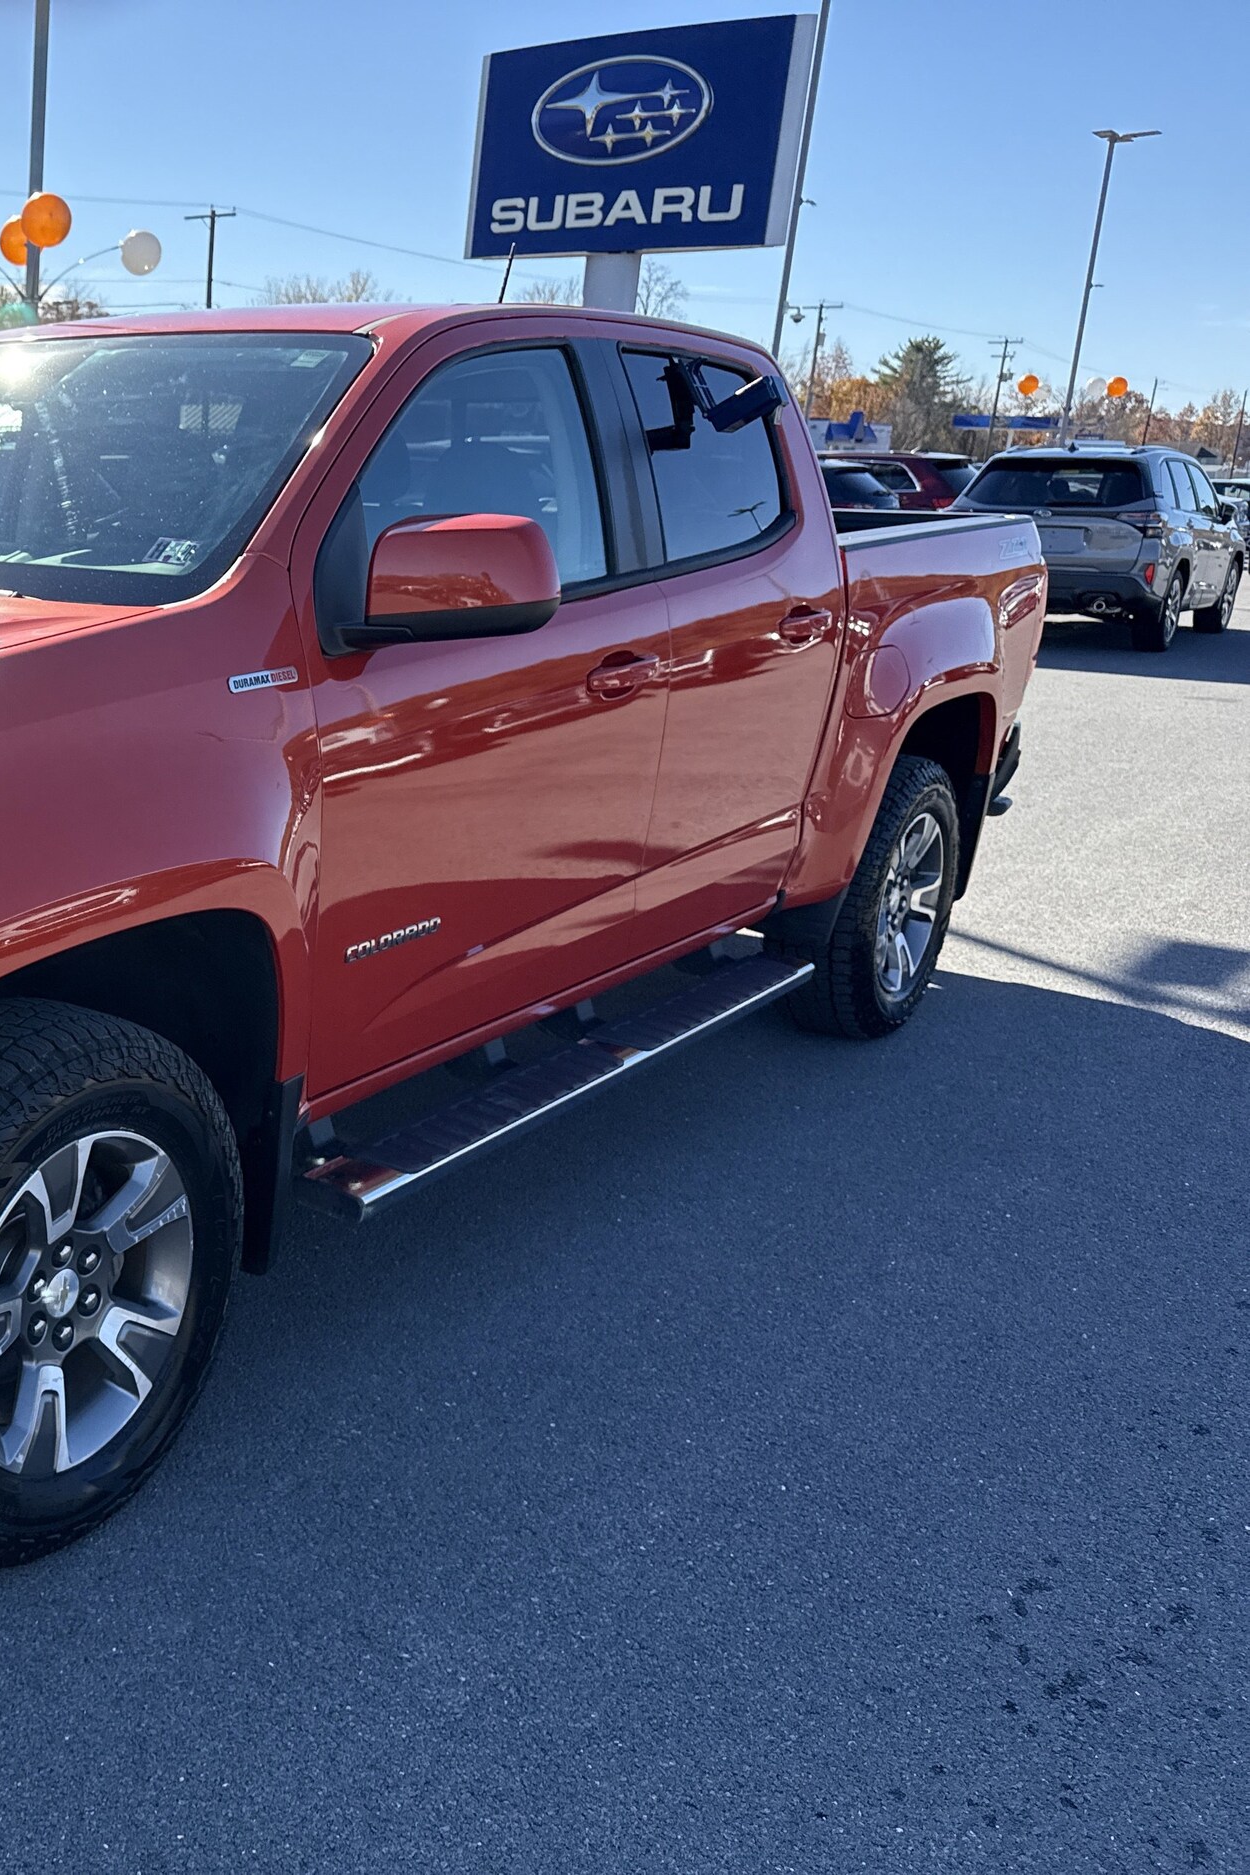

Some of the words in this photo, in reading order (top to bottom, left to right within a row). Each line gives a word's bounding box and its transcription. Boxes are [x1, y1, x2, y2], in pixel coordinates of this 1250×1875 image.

[490, 184, 744, 234] SUBARU
[233, 673, 271, 689] DURAMAX
[270, 670, 296, 683] DIESEL
[344, 916, 441, 963] COLORADO
[46, 1094, 142, 1138] DISCOVERER
